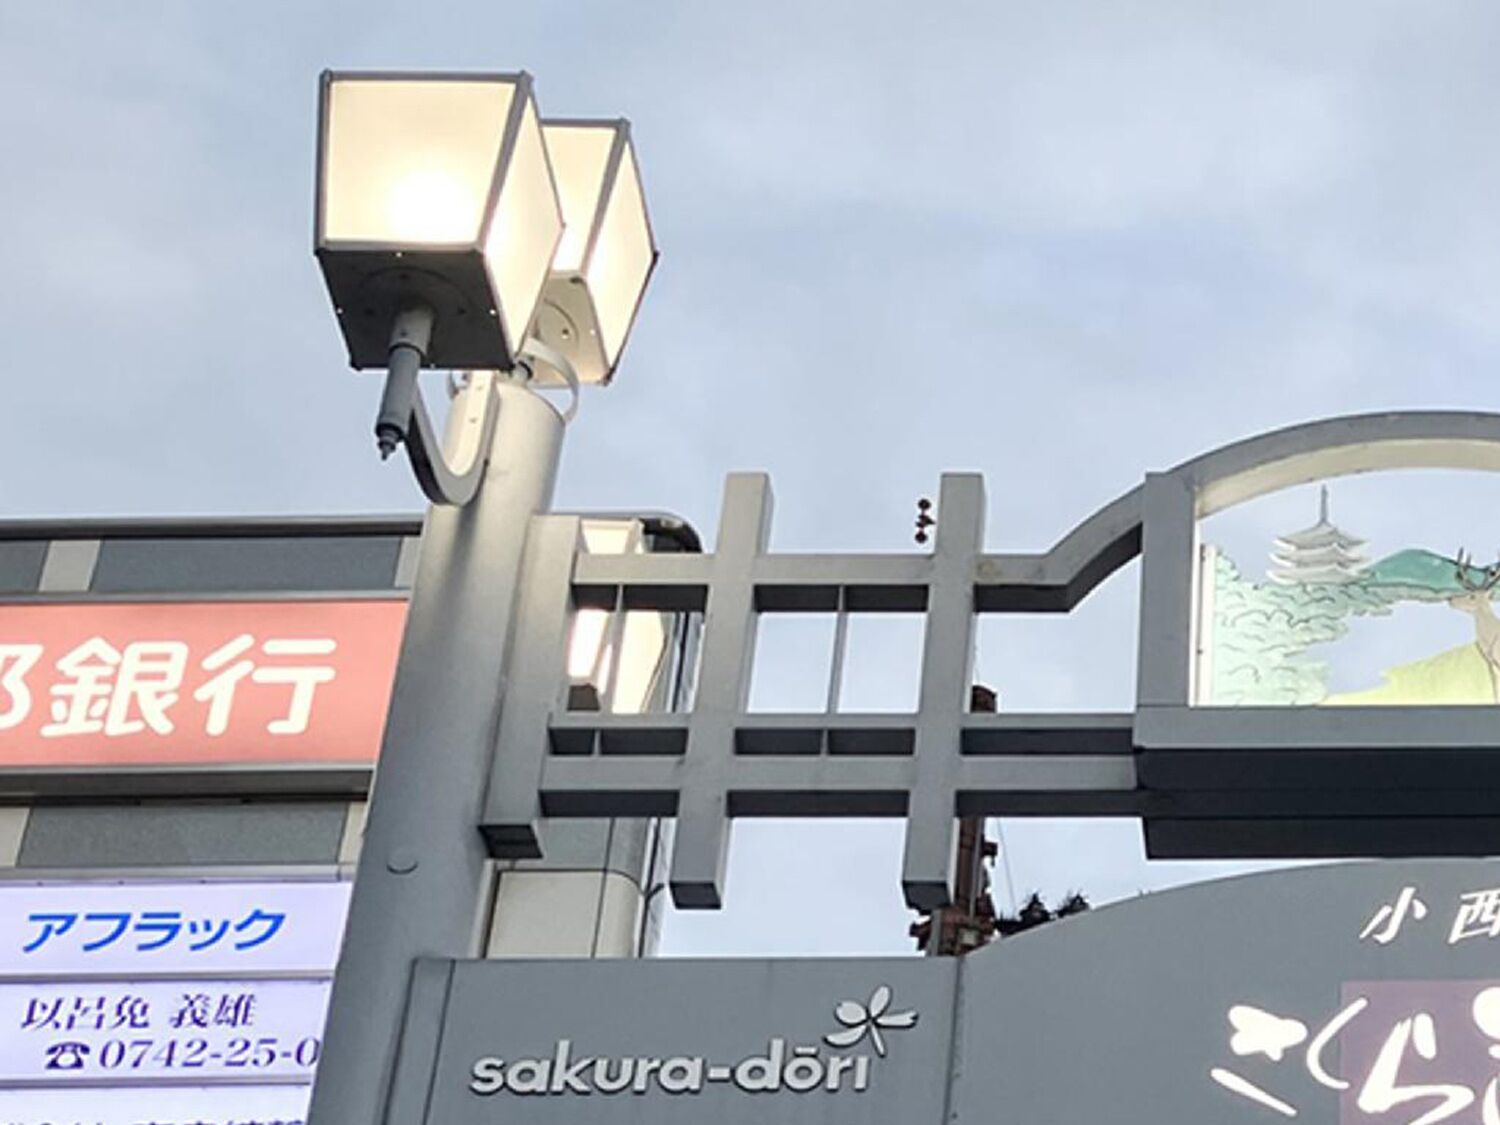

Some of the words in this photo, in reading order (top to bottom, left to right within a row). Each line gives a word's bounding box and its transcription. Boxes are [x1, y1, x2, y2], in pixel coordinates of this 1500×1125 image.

[0, 634, 337, 738] 銀行
[23, 909, 286, 953] アフラック
[169, 993, 256, 1029] 義雄
[99, 1037, 320, 1069] 0742-25-0
[470, 1038, 869, 1093] sakura-dōri
